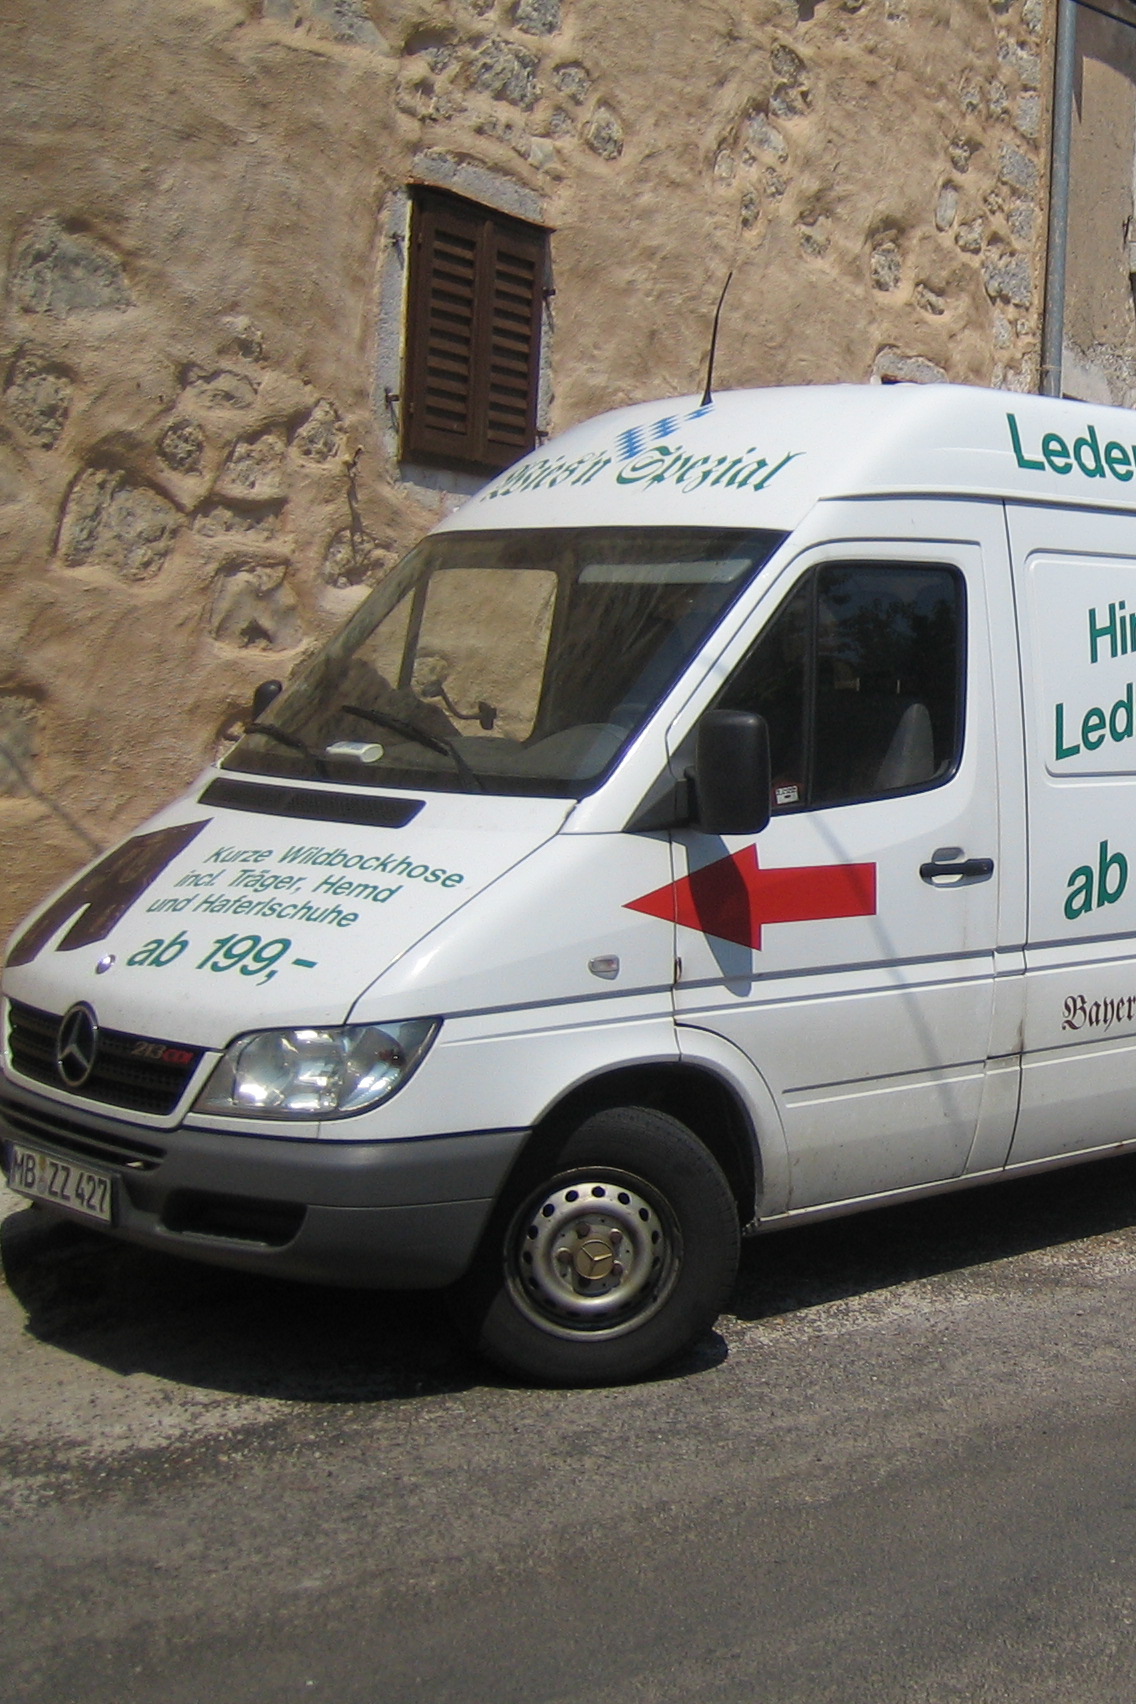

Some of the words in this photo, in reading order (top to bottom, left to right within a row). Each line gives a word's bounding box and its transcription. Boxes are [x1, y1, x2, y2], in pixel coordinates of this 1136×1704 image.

[616, 445, 806, 494] Spezial
[173, 869, 217, 887] incl.
[227, 869, 306, 894] Träger,
[311, 874, 403, 903] Hemd
[203, 846, 273, 864] Kurze
[278, 846, 465, 889] Wildbockhose
[1063, 839, 1129, 921] ab
[146, 896, 194, 913] und
[193, 893, 359, 928] Haferlschuhe
[126, 930, 190, 967] ab
[196, 933, 319, 987] 199,-
[75, 1171, 108, 1214] 427
